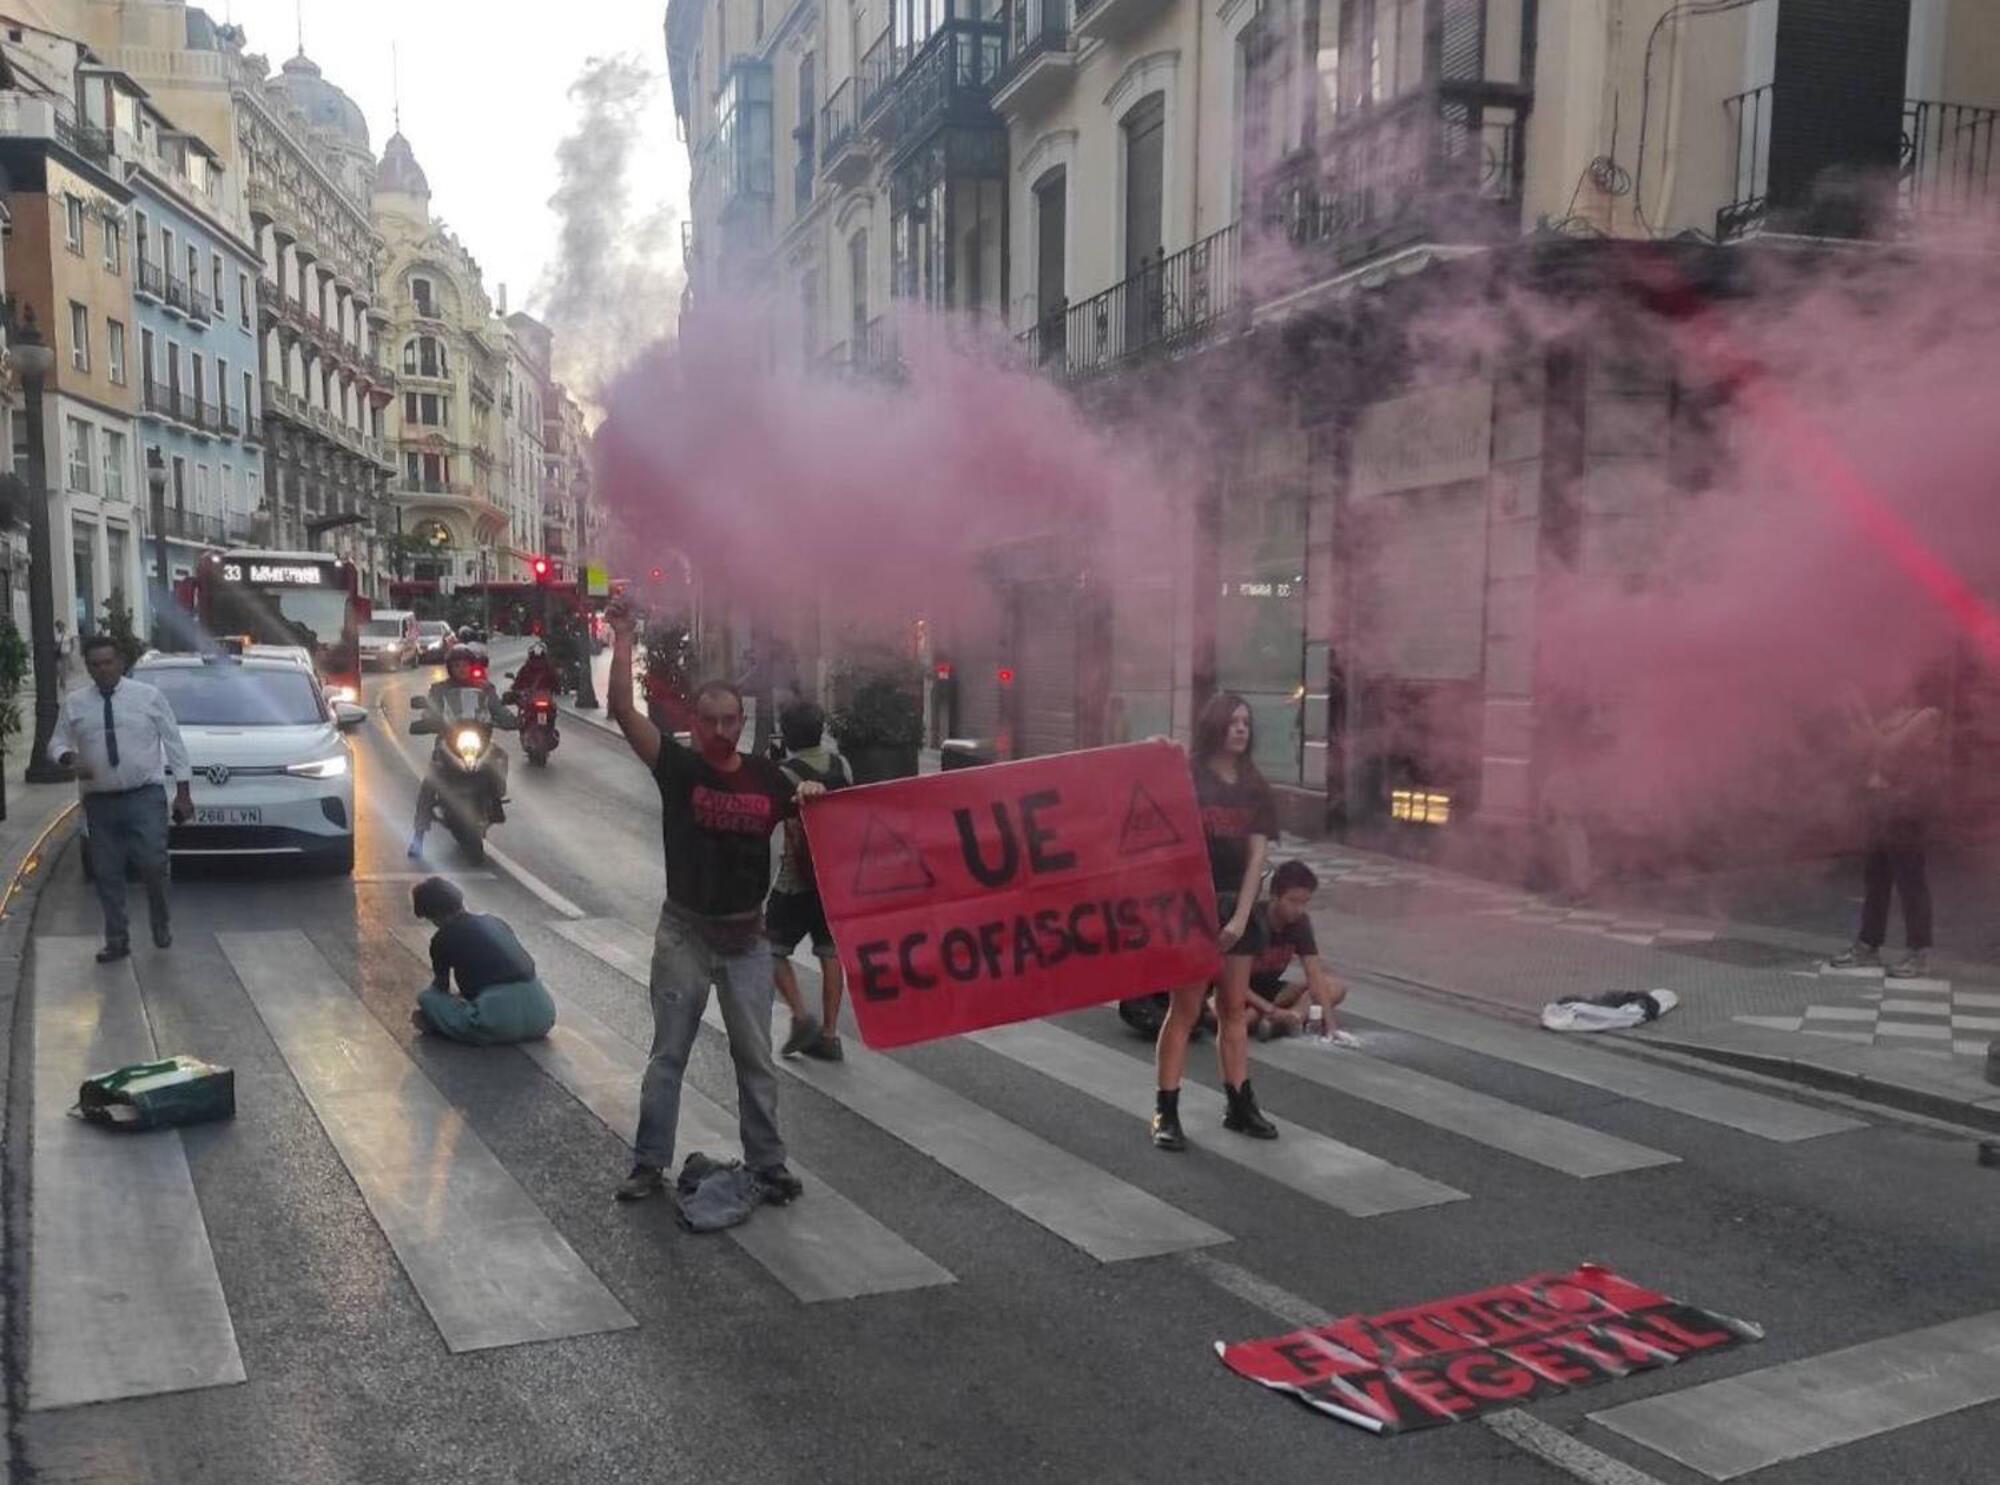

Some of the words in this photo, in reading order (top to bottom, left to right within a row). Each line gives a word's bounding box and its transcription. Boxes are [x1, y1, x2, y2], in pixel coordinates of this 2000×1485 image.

[223, 565, 241, 581] 33
[953, 790, 1077, 889] UE
[856, 894, 1204, 1000] ECOFASCISTA
